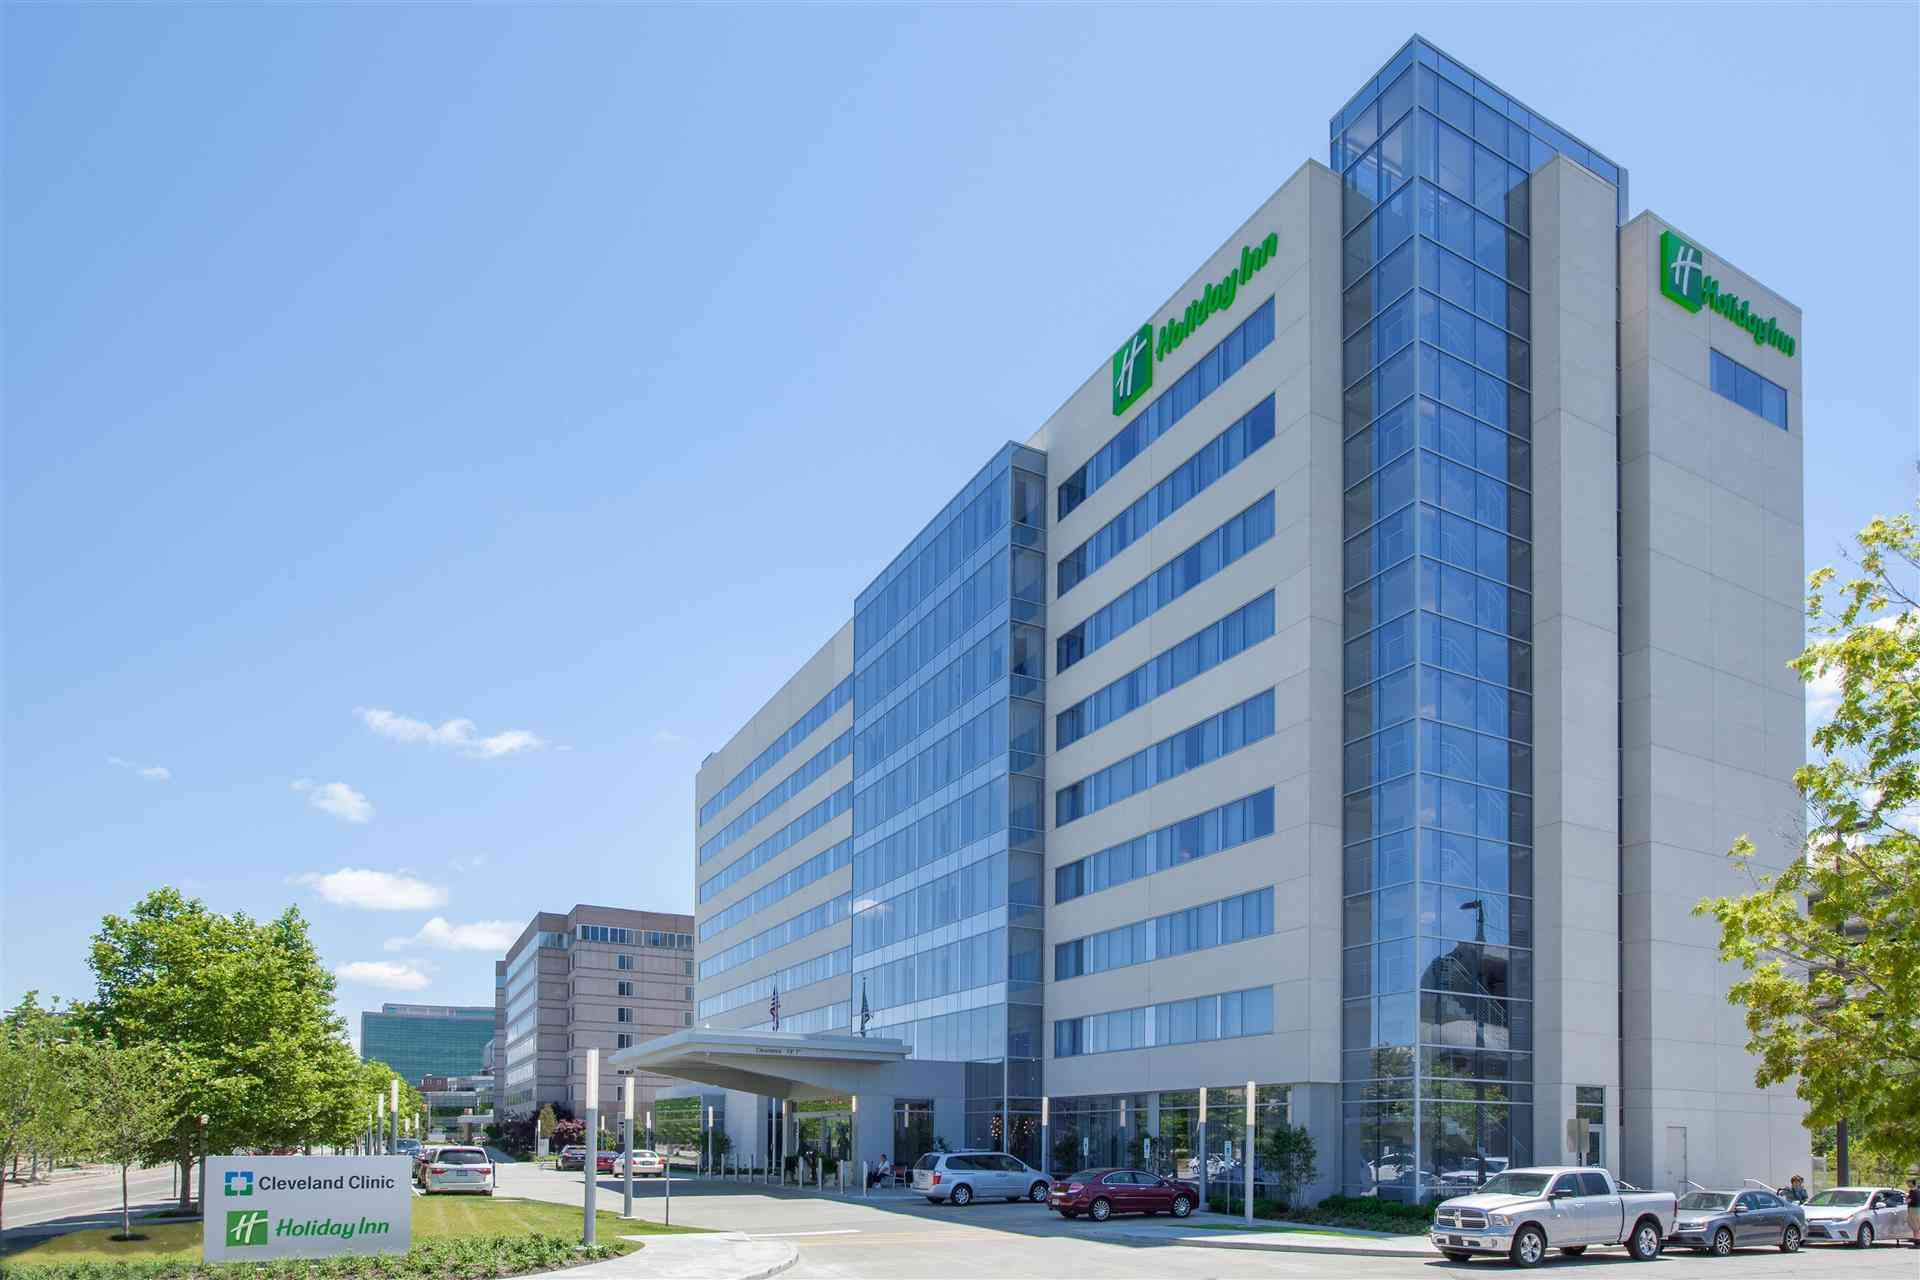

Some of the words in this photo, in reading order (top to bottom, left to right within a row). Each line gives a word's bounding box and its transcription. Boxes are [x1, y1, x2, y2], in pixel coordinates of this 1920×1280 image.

[1156, 269, 1239, 362] Holiday
[1240, 232, 1278, 285] Inn
[1702, 275, 1768, 346] Holiday
[1768, 317, 1796, 357] Inn
[258, 1176, 343, 1191] Cleveland
[348, 1175, 395, 1190] Clinic
[276, 1218, 356, 1238] Holiday
[358, 1216, 390, 1234] Inn
